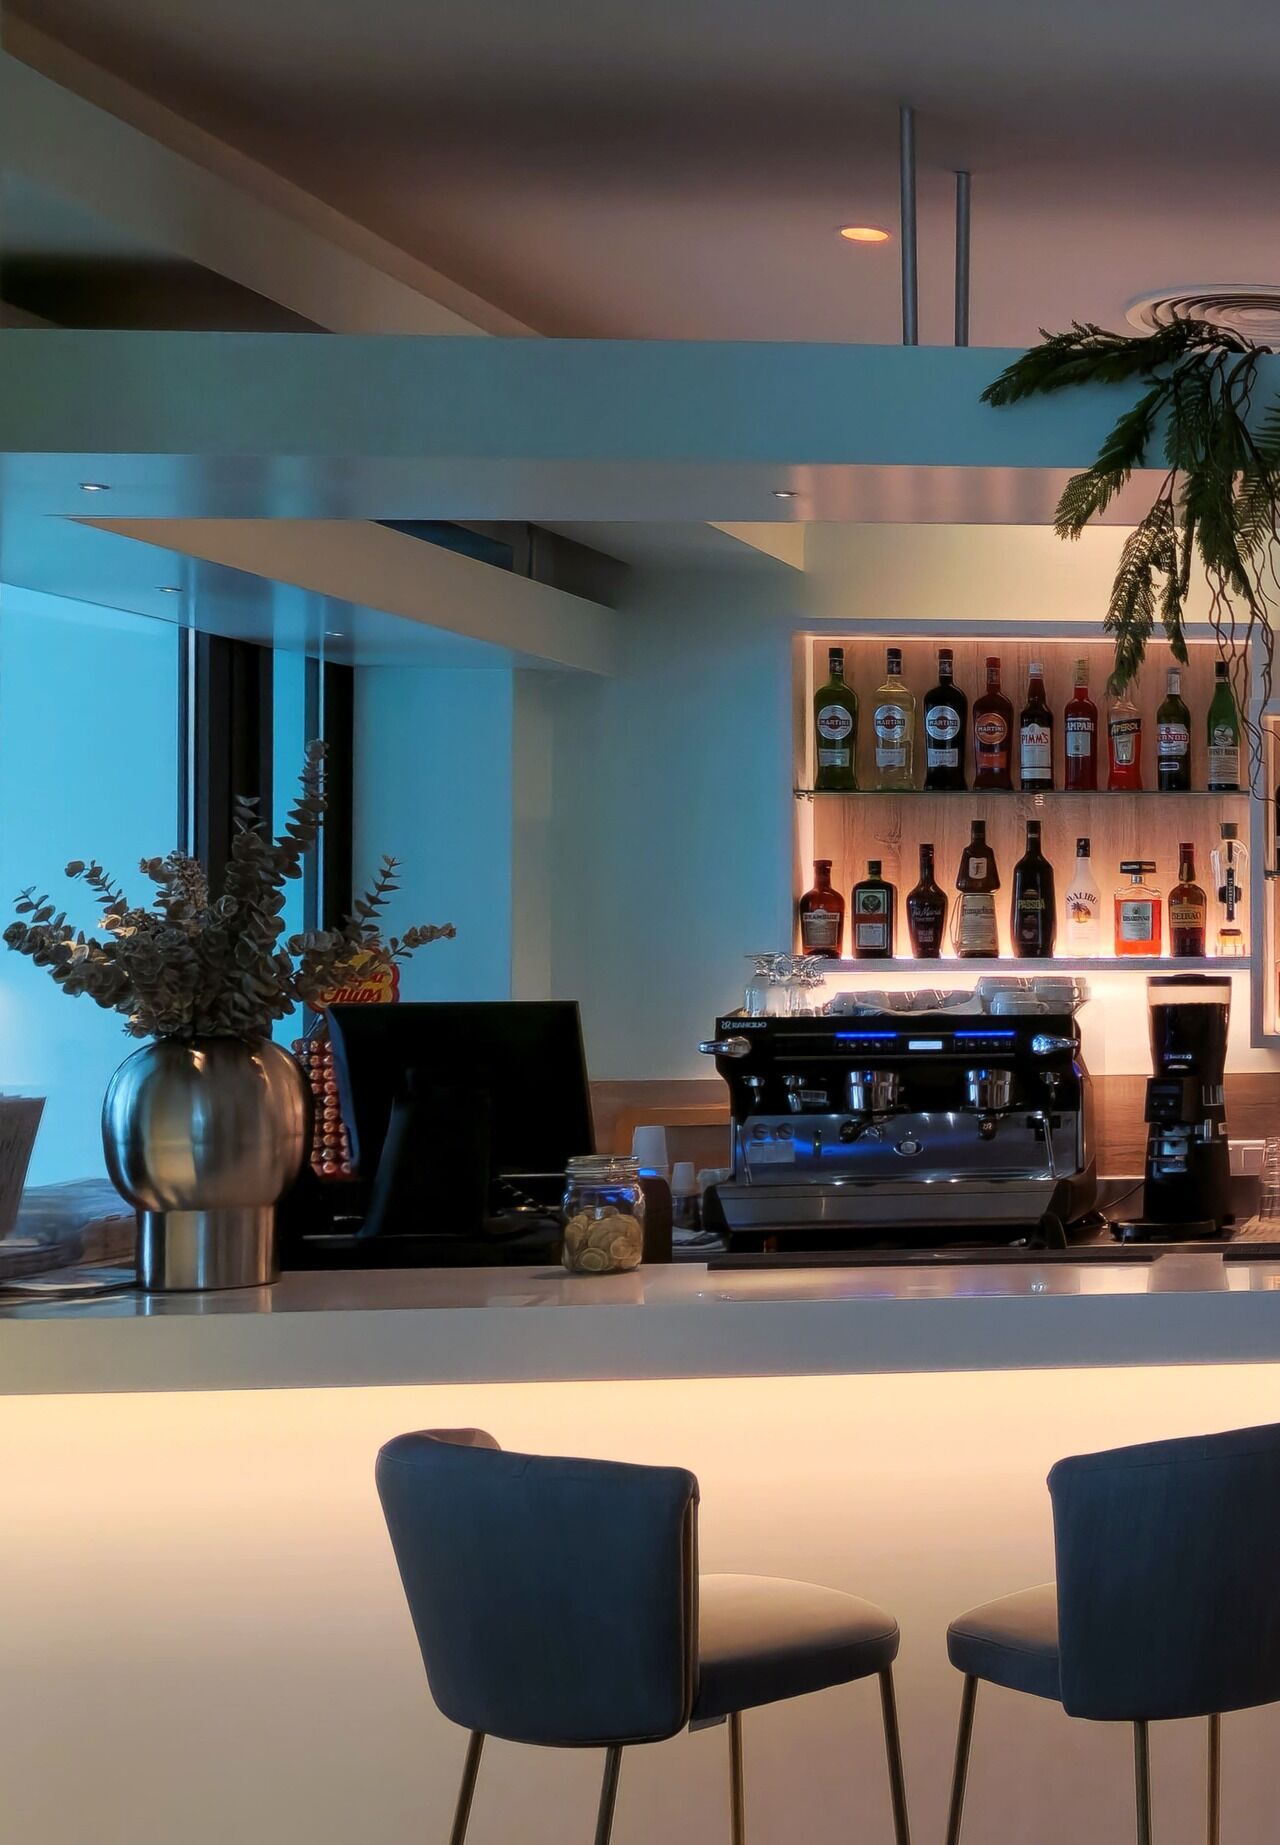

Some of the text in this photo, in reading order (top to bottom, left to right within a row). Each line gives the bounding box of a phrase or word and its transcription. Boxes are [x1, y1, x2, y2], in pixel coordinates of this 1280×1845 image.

[928, 719, 958, 727] MARTINI
[1067, 722, 1094, 731] AMPARI
[1021, 732, 1049, 745] PIMM'S
[1066, 892, 1097, 904] MALIBU
